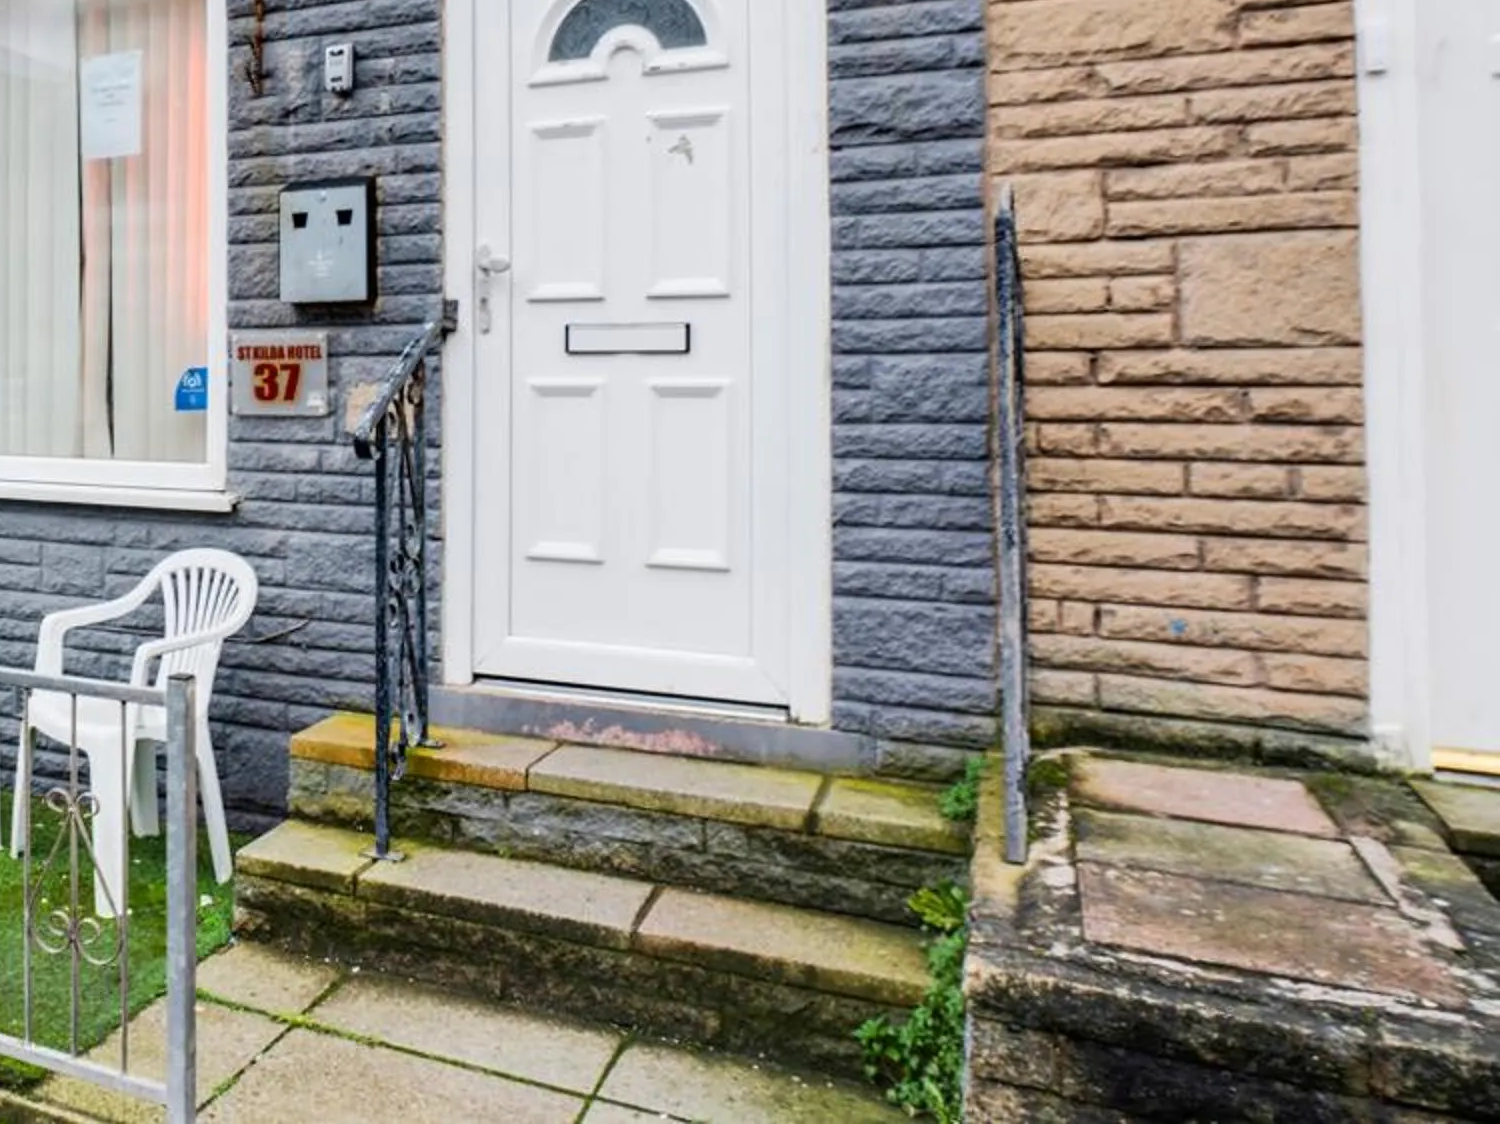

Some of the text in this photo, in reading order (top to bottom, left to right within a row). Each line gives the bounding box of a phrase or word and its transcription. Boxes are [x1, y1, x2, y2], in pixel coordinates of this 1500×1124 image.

[237, 344, 322, 360] ST KILDA HOTEL
[254, 363, 300, 402] 37
